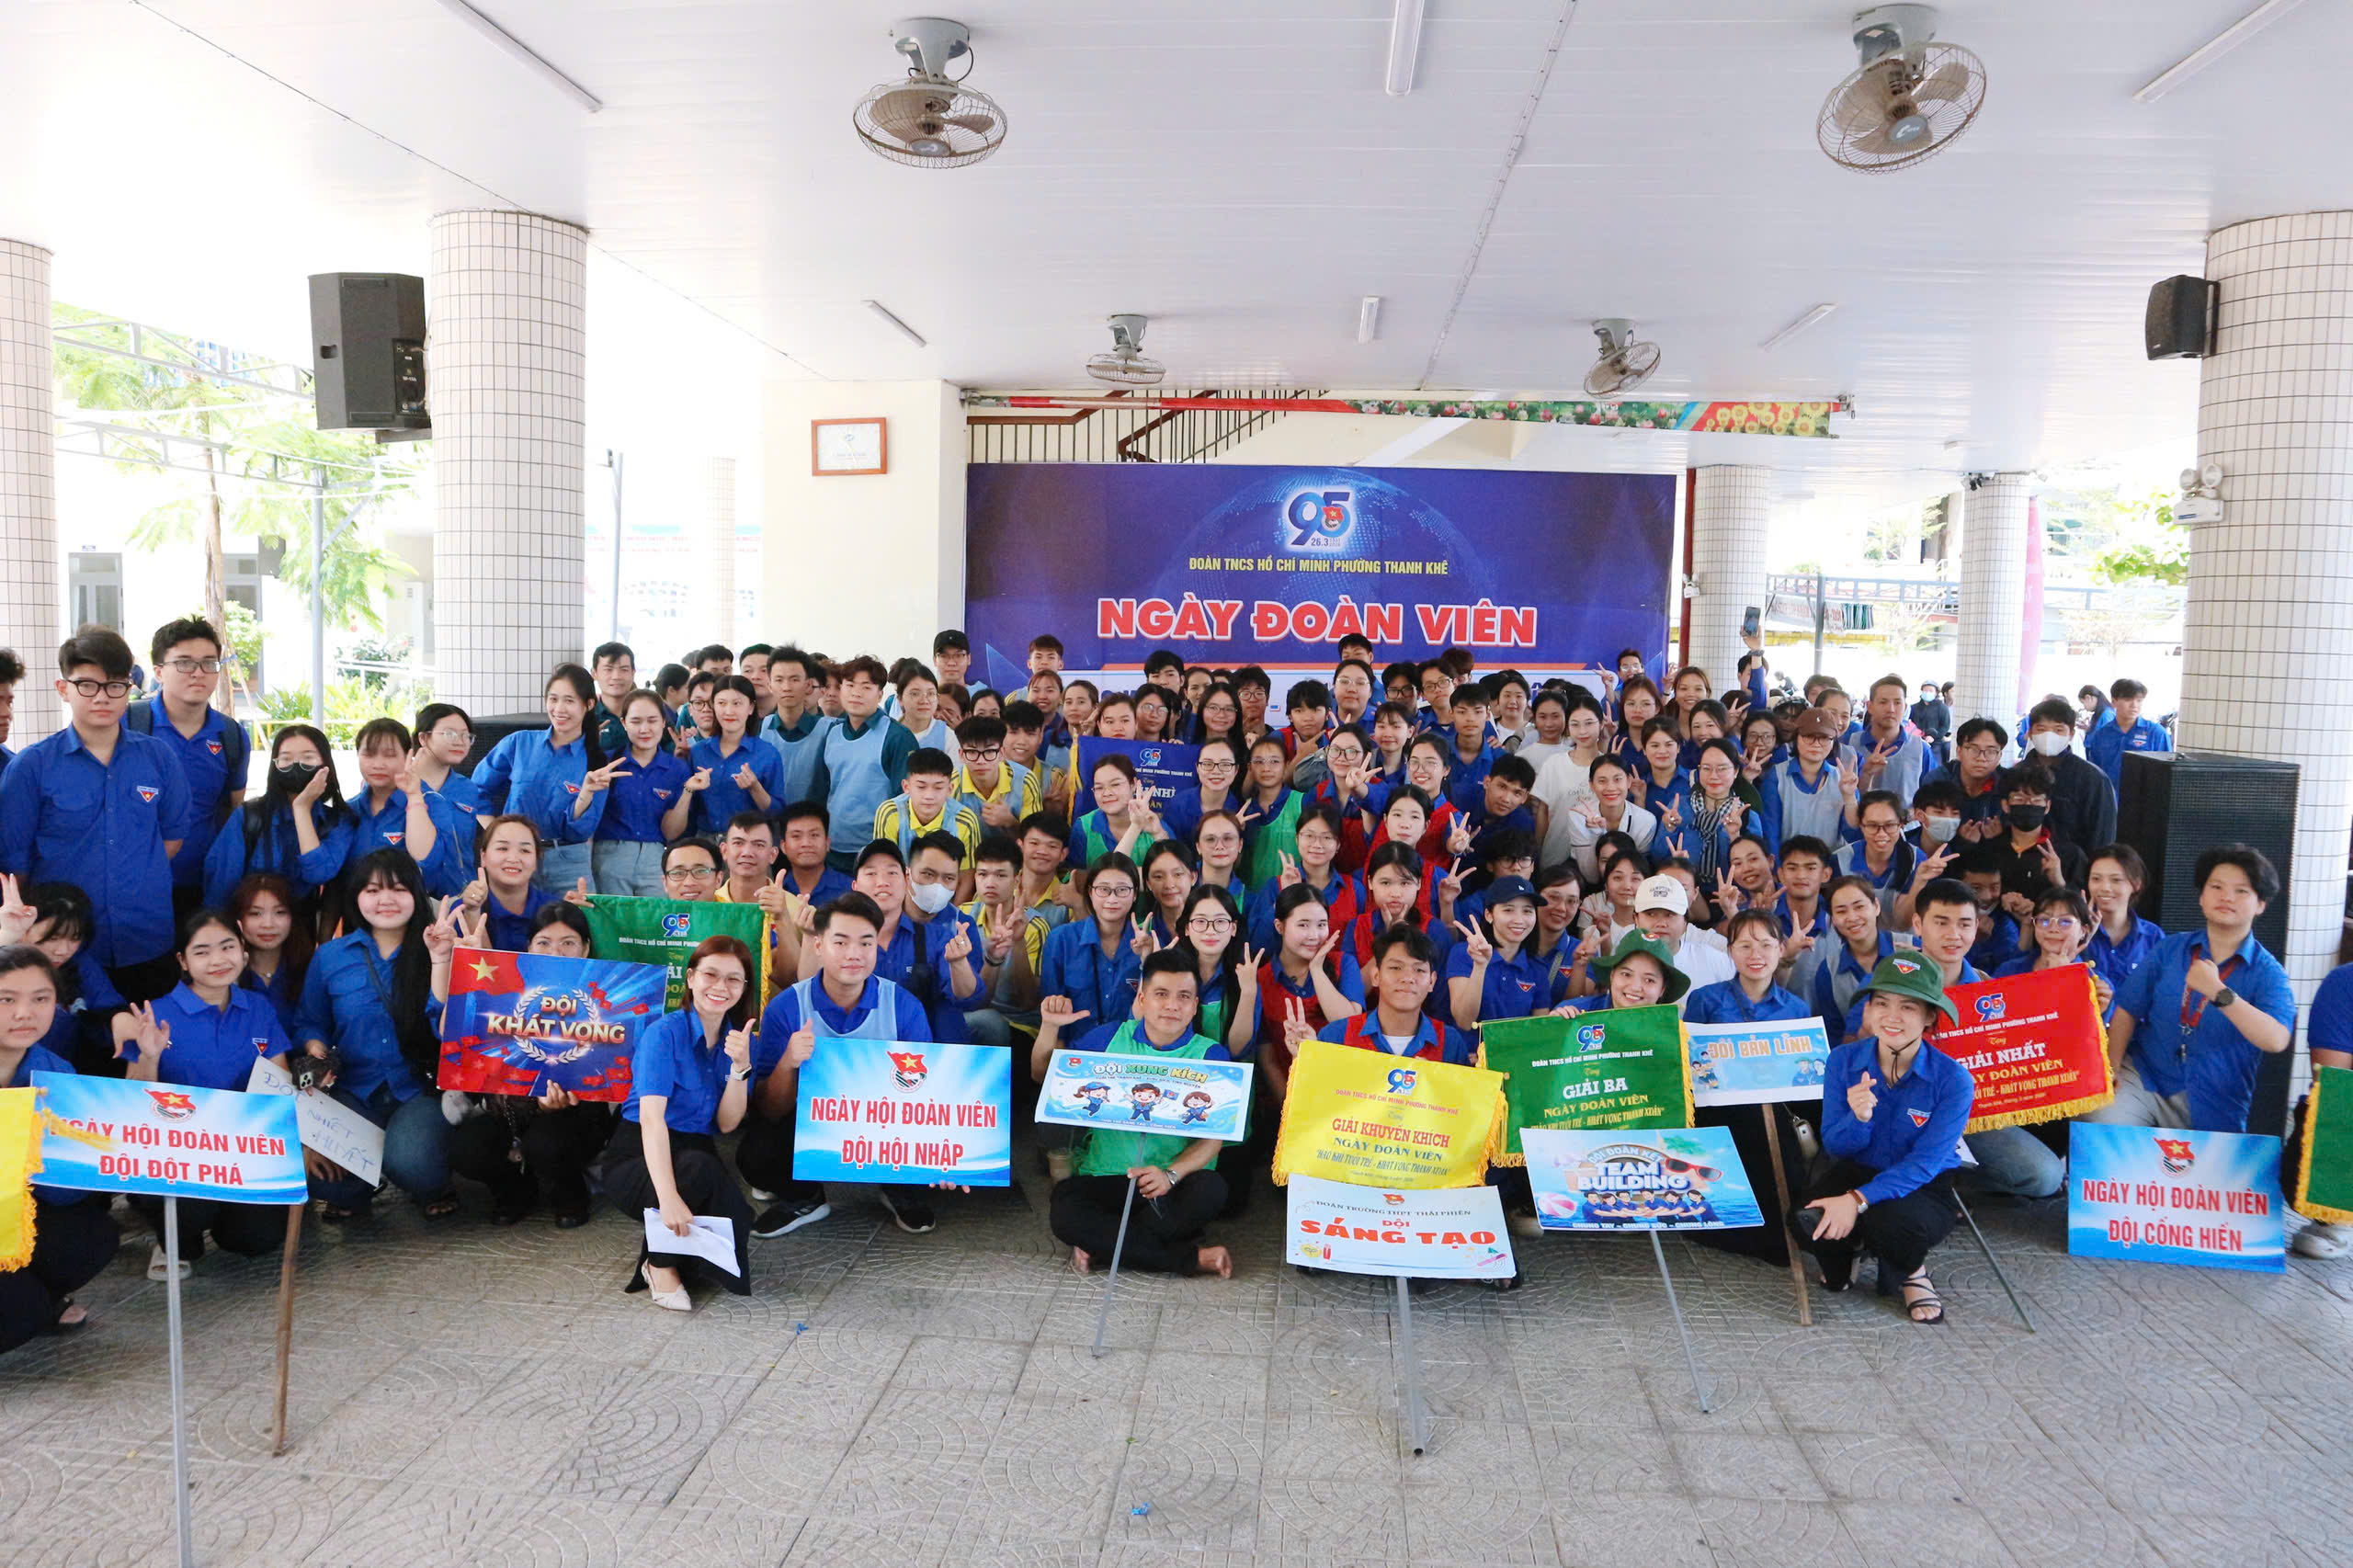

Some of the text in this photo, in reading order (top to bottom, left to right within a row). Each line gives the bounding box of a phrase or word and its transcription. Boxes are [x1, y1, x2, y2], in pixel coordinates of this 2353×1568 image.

[1289, 492, 1350, 545] 95
[1311, 538, 1329, 547] 26.3
[1188, 555, 1449, 574] ĐOÀN TNCS HỒ CHÍ MINH PHƯỜNG THANH KHÊ
[1099, 593, 1538, 647] NGÀY ĐOÀN VIÊN
[667, 962, 682, 979] ẢI
[540, 995, 577, 1016] ĐỘI
[487, 1014, 625, 1046] KHÁT VỌNG
[1738, 1031, 1771, 1057] BẢN
[1774, 1033, 1813, 1055] LĨNH
[1997, 1040, 2046, 1064] NHẤT
[1094, 1062, 1122, 1076] ĐỘI
[1125, 1063, 1168, 1076] XUNG
[1170, 1066, 1209, 1084] KÍCH
[1990, 1064, 2029, 1082] ĐOÀN
[2032, 1059, 2064, 1074] VIÊN
[1563, 1077, 1629, 1100] GIẢI BA
[812, 1094, 996, 1129] NGÀY HỘI ĐOÀN VIÊN
[1543, 1094, 1649, 1119] NGÀY ĐOÀN VIÊN
[122, 1124, 160, 1148] HỘI
[168, 1129, 228, 1151] ĐOÀN
[235, 1134, 285, 1155] VIÊN
[1332, 1116, 1450, 1148] GIẢI KHUYẾN KHÍCH
[842, 1135, 964, 1172] ĐỘI HỘI NHẬP
[1334, 1137, 1442, 1162] NGÀY ĐOÀN VIÊN
[100, 1153, 244, 1186] ĐỘI ĐỘT PHÁ
[1595, 1162, 1661, 1176] TEAM
[1576, 1175, 1690, 1191] BUILDING
[1316, 1200, 1344, 1210] ĐOÀN
[2083, 1177, 2268, 1216] NGÀY HỘI ĐOÀN VIÊN
[1301, 1217, 1496, 1249] SÁNG TẠO
[1382, 1218, 1410, 1230] ĐỘI
[2109, 1216, 2243, 1252] ĐỘI CỐNG HIẾN
